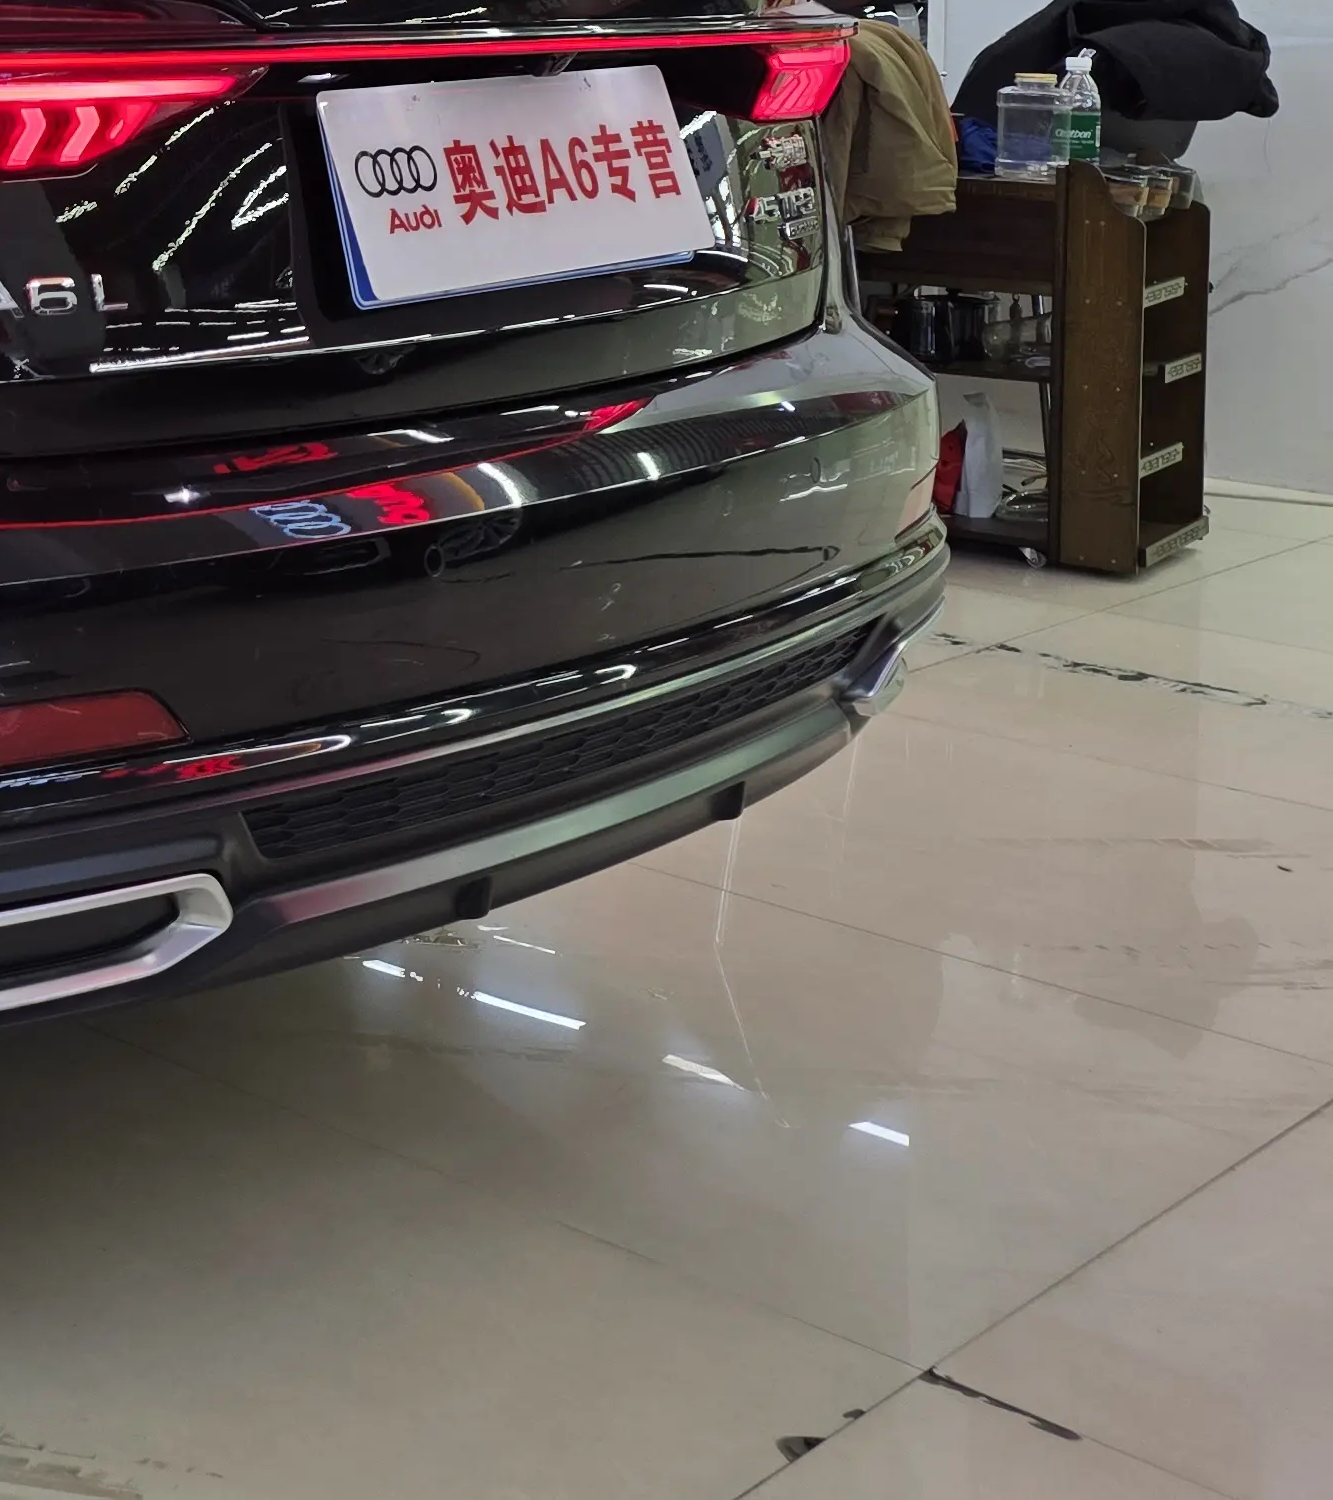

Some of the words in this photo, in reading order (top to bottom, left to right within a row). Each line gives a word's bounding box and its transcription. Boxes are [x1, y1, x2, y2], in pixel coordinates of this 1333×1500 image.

[442, 119, 682, 226] 奥迪A6专营
[389, 204, 443, 235] Audi
